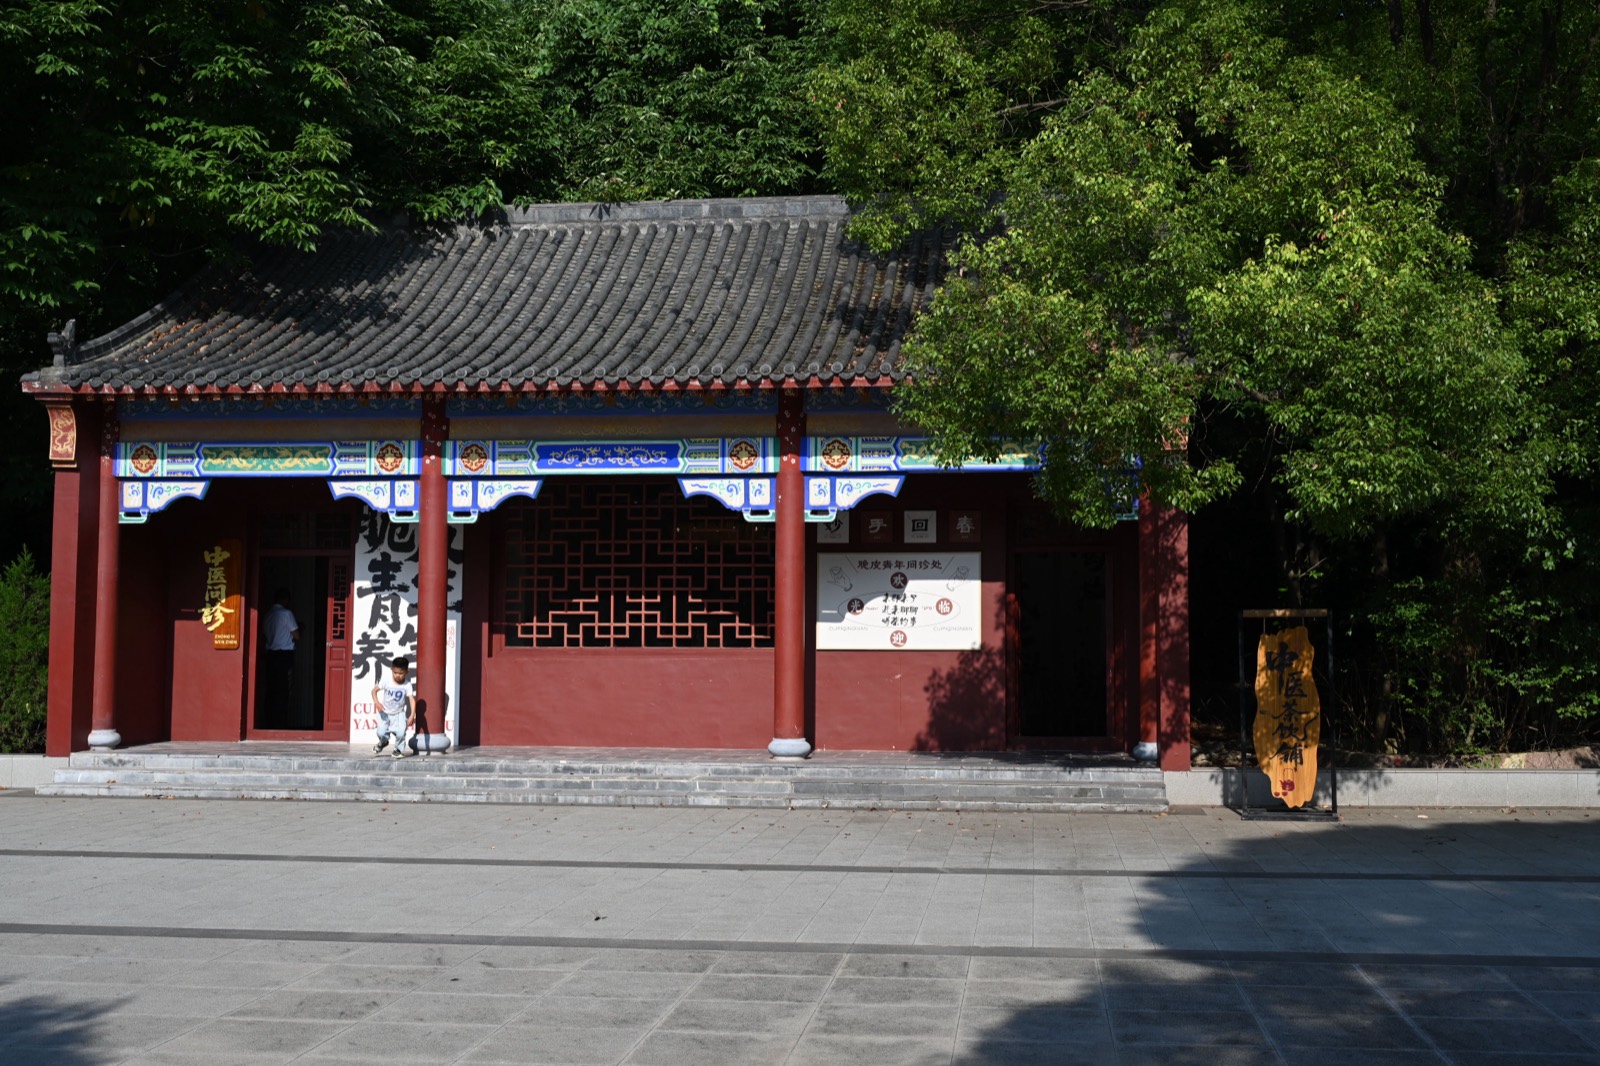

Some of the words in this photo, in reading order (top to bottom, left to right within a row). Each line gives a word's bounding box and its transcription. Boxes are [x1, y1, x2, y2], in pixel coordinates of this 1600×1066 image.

[868, 518, 888, 534] 手
[911, 518, 929, 532] 回
[955, 515, 975, 534] 春
[891, 573, 906, 588] 欢
[849, 600, 864, 615] 光
[937, 599, 952, 614] 临
[891, 631, 906, 646] 迎
